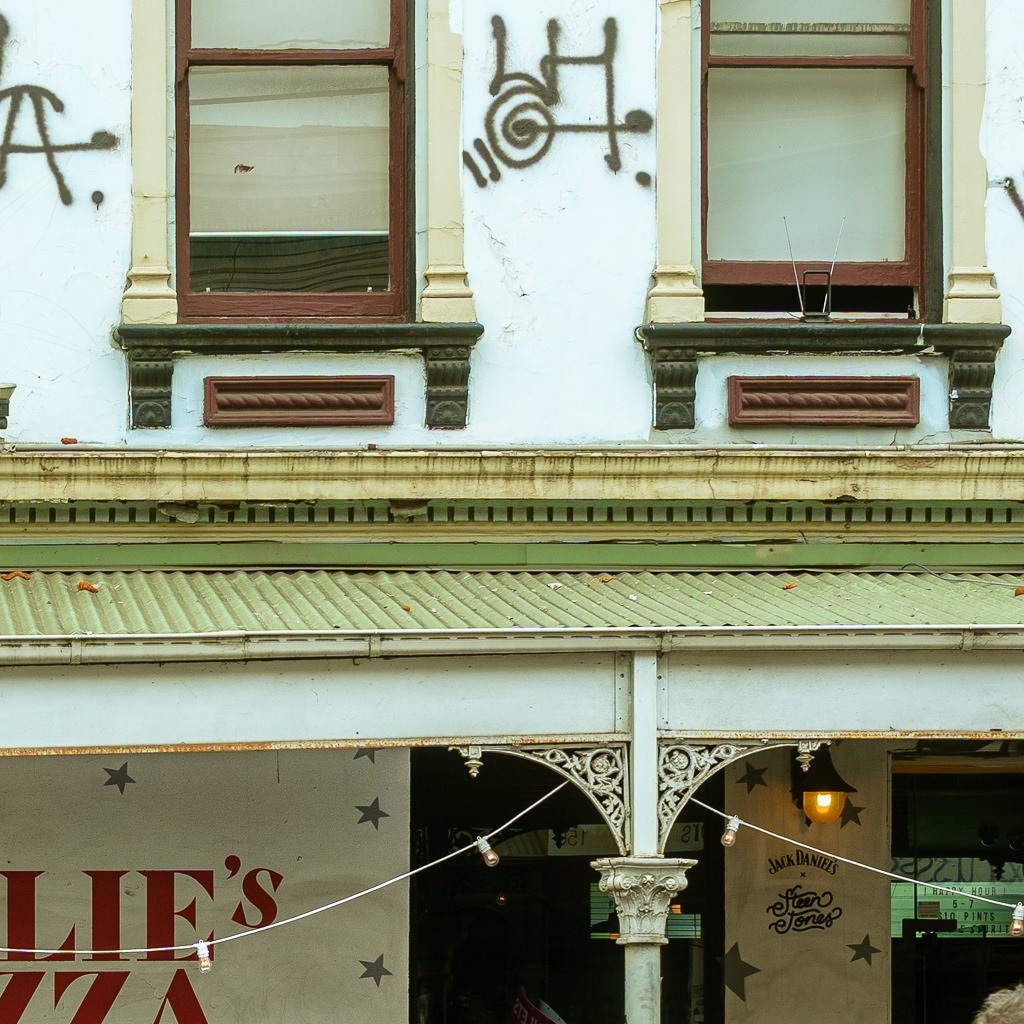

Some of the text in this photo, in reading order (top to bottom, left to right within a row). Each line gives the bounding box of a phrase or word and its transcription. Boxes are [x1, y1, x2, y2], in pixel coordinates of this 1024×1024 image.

[768, 854, 795, 874] JACK
[933, 887, 964, 896] HAPPY
[972, 887, 996, 896] HOUR
[964, 912, 995, 921] PINTS
